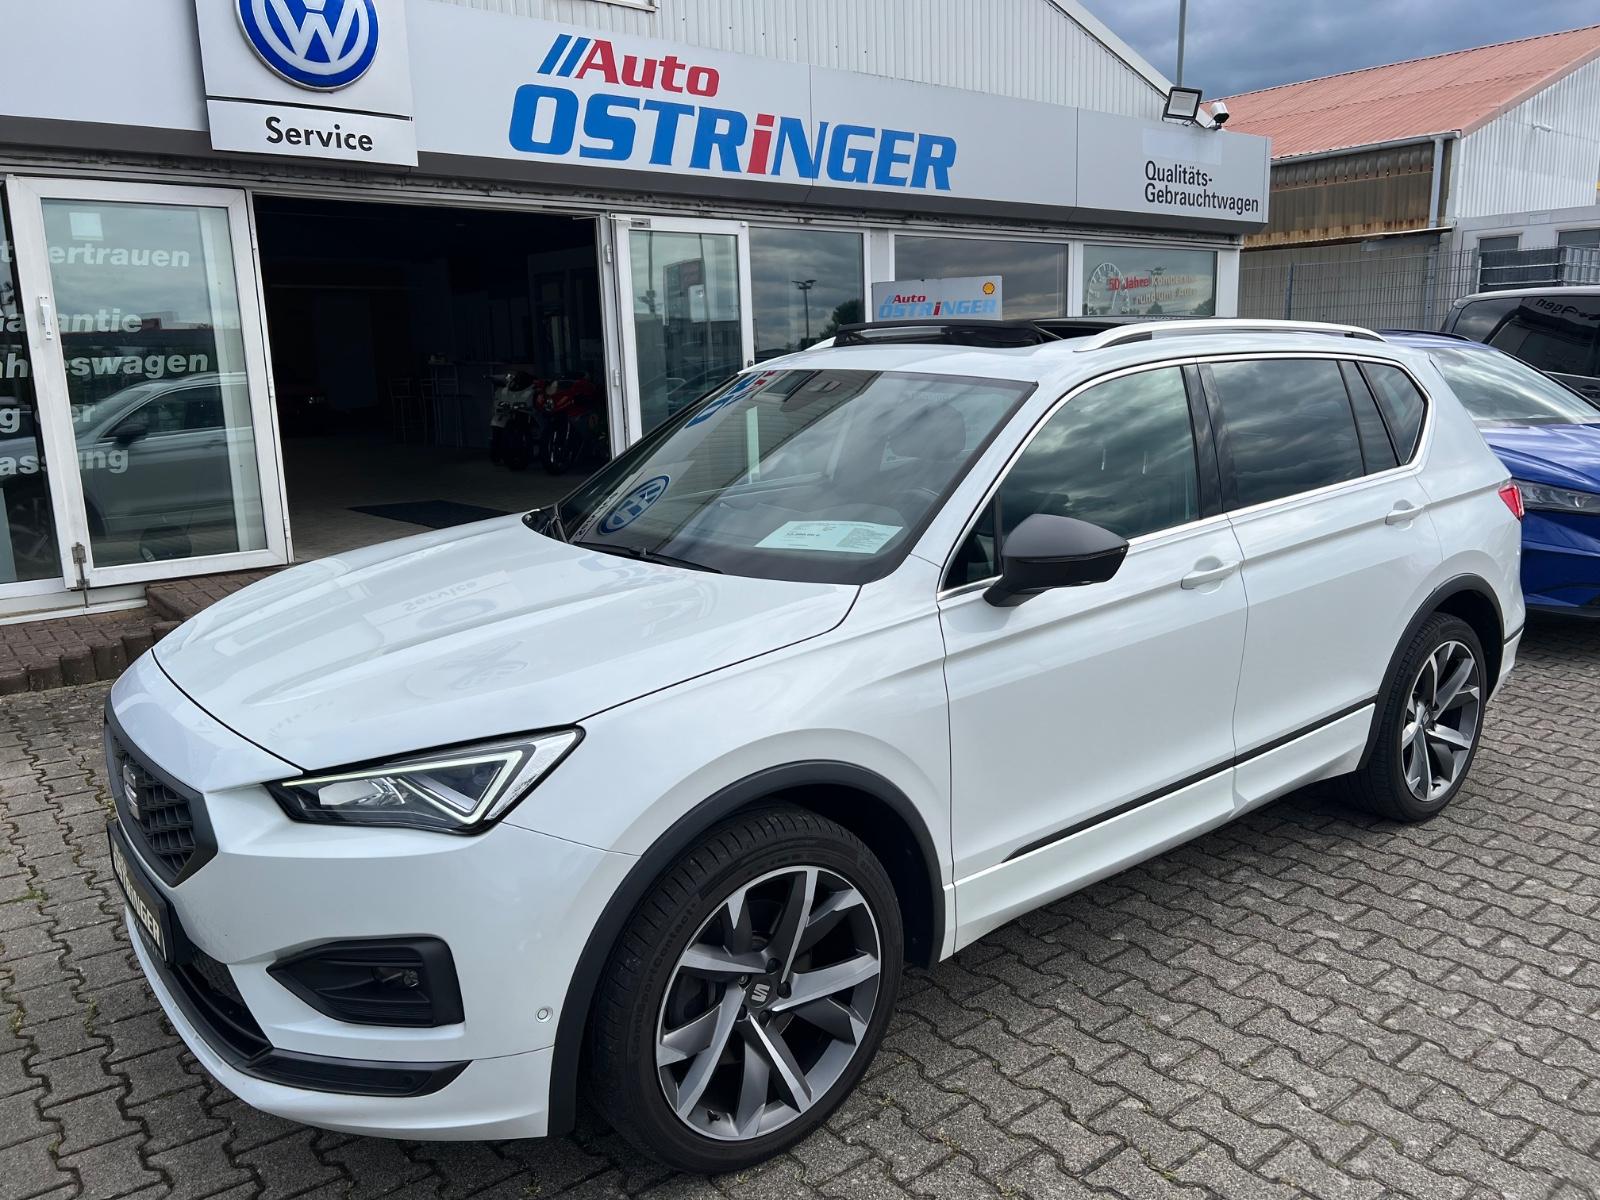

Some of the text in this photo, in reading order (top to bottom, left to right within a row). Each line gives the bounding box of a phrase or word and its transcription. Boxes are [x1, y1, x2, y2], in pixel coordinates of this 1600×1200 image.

[265, 116, 373, 151] Service
[1145, 160, 1213, 186] Qualitäts-
[1144, 183, 1259, 215] Gebrauchtwagen
[49, 243, 190, 267] ertrauen
[1124, 275, 1149, 290] Jahre
[892, 294, 926, 304] Auto
